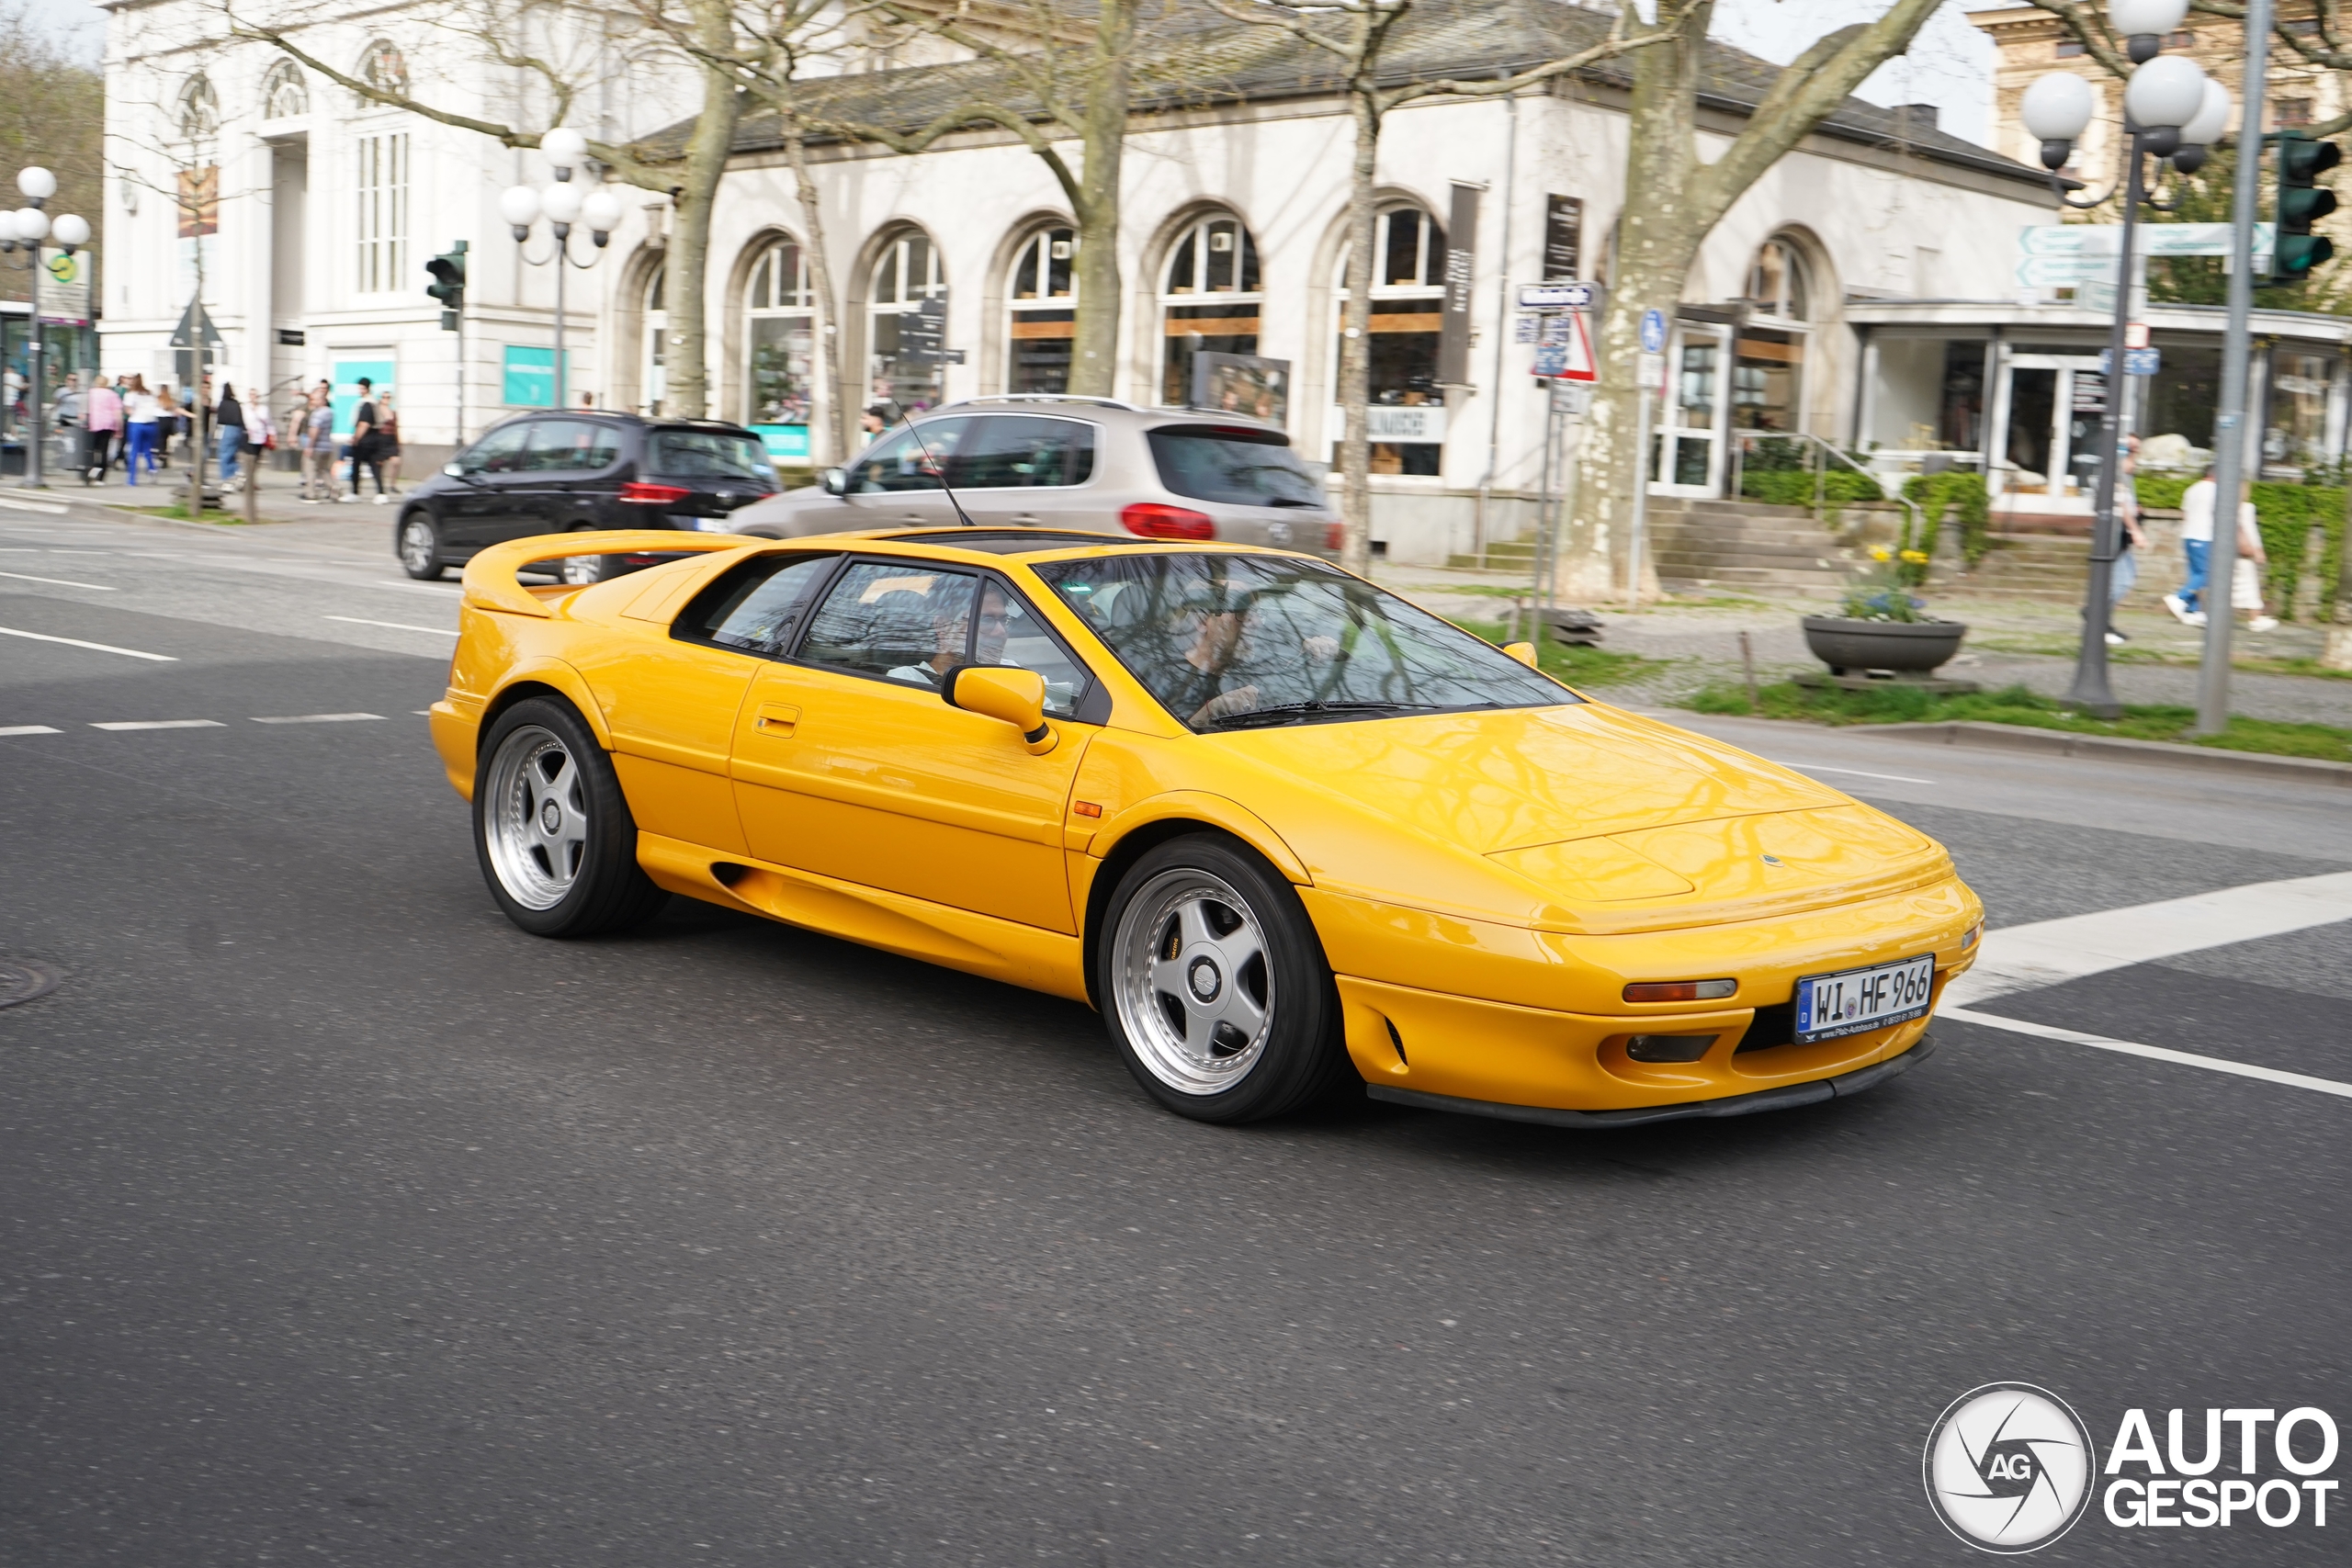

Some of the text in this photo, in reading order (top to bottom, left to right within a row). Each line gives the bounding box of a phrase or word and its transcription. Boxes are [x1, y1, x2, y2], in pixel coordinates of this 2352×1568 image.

[1817, 964, 1928, 1023] WI HF 966
[1801, 1012, 1808, 1023] D
